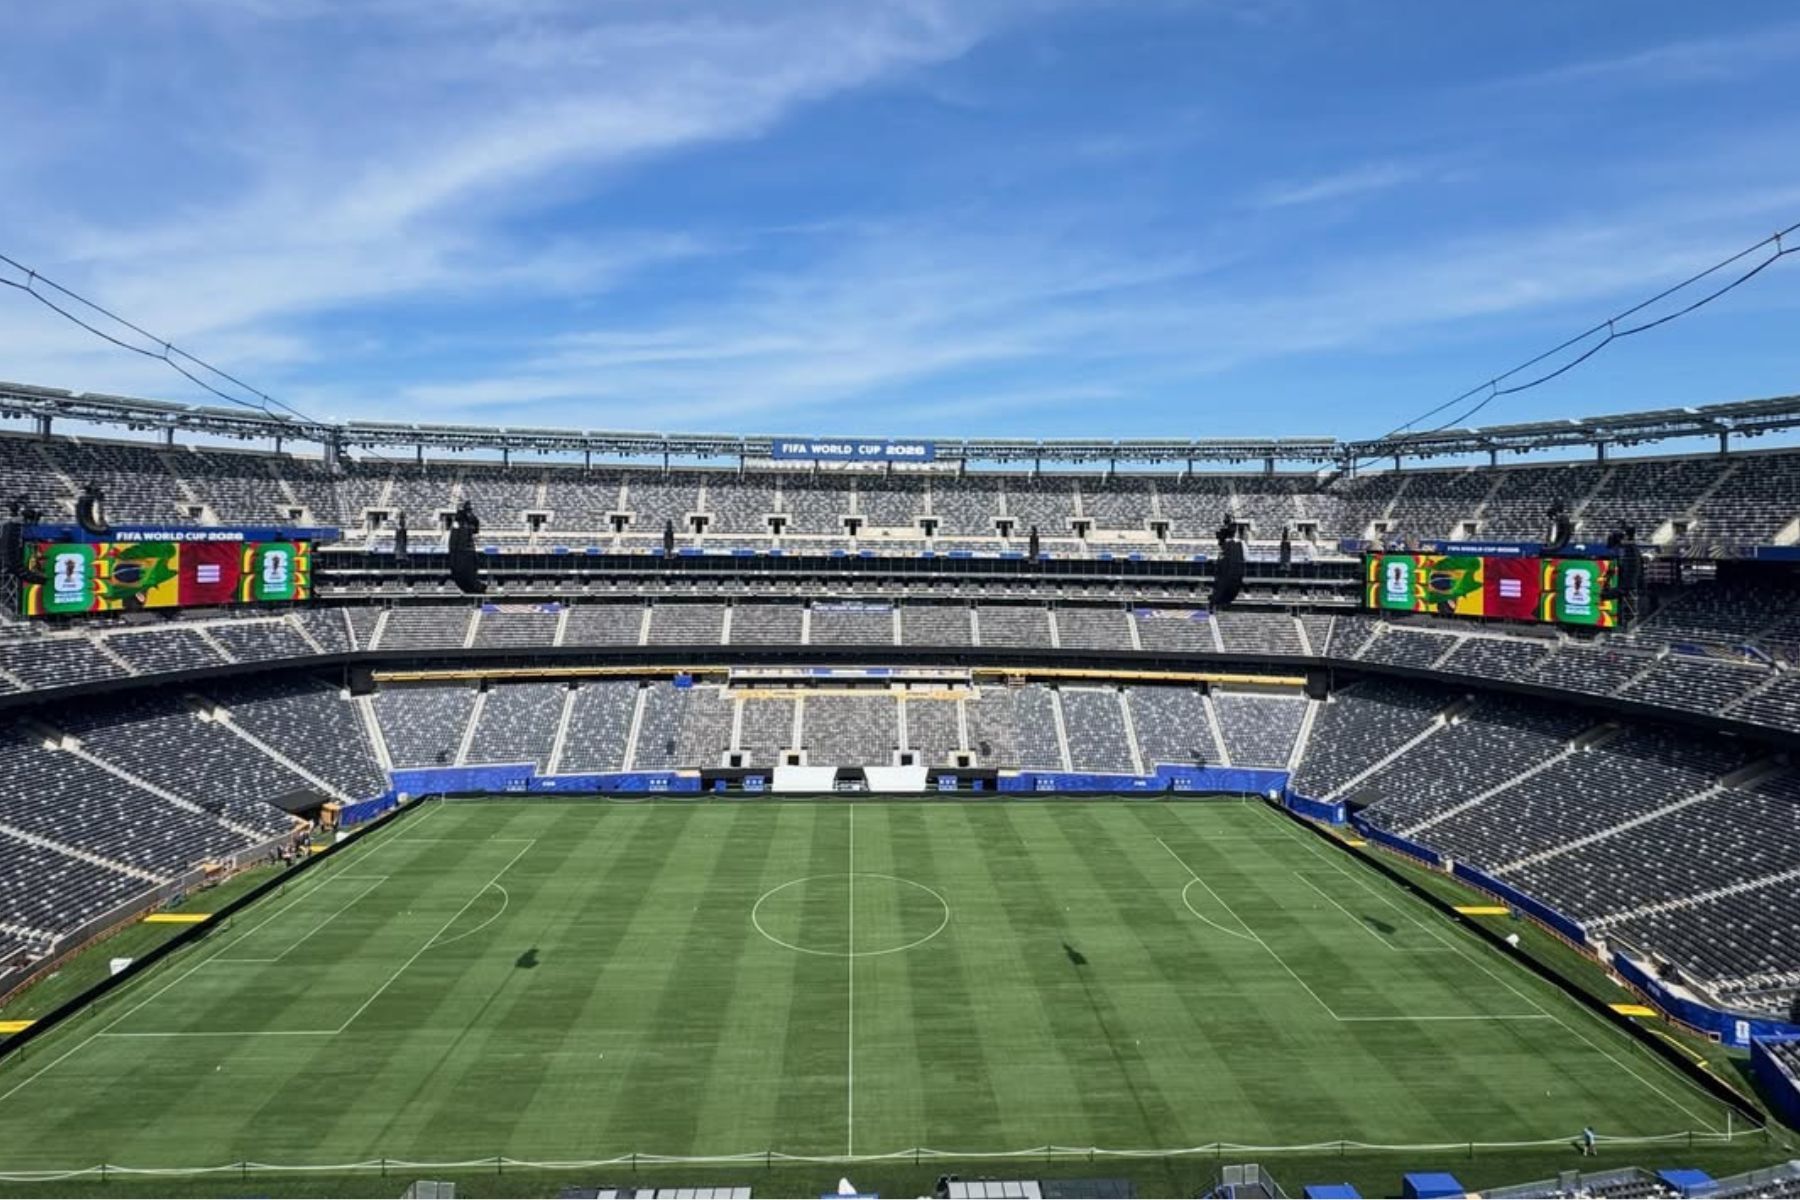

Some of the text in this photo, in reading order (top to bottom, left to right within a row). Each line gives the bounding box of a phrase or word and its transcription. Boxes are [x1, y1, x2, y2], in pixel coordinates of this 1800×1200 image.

[782, 443, 925, 455] FIFA WORLD CUP 2026
[116, 532, 142, 541] FIFA
[143, 532, 184, 541] WORLD
[185, 532, 207, 541] CUP
